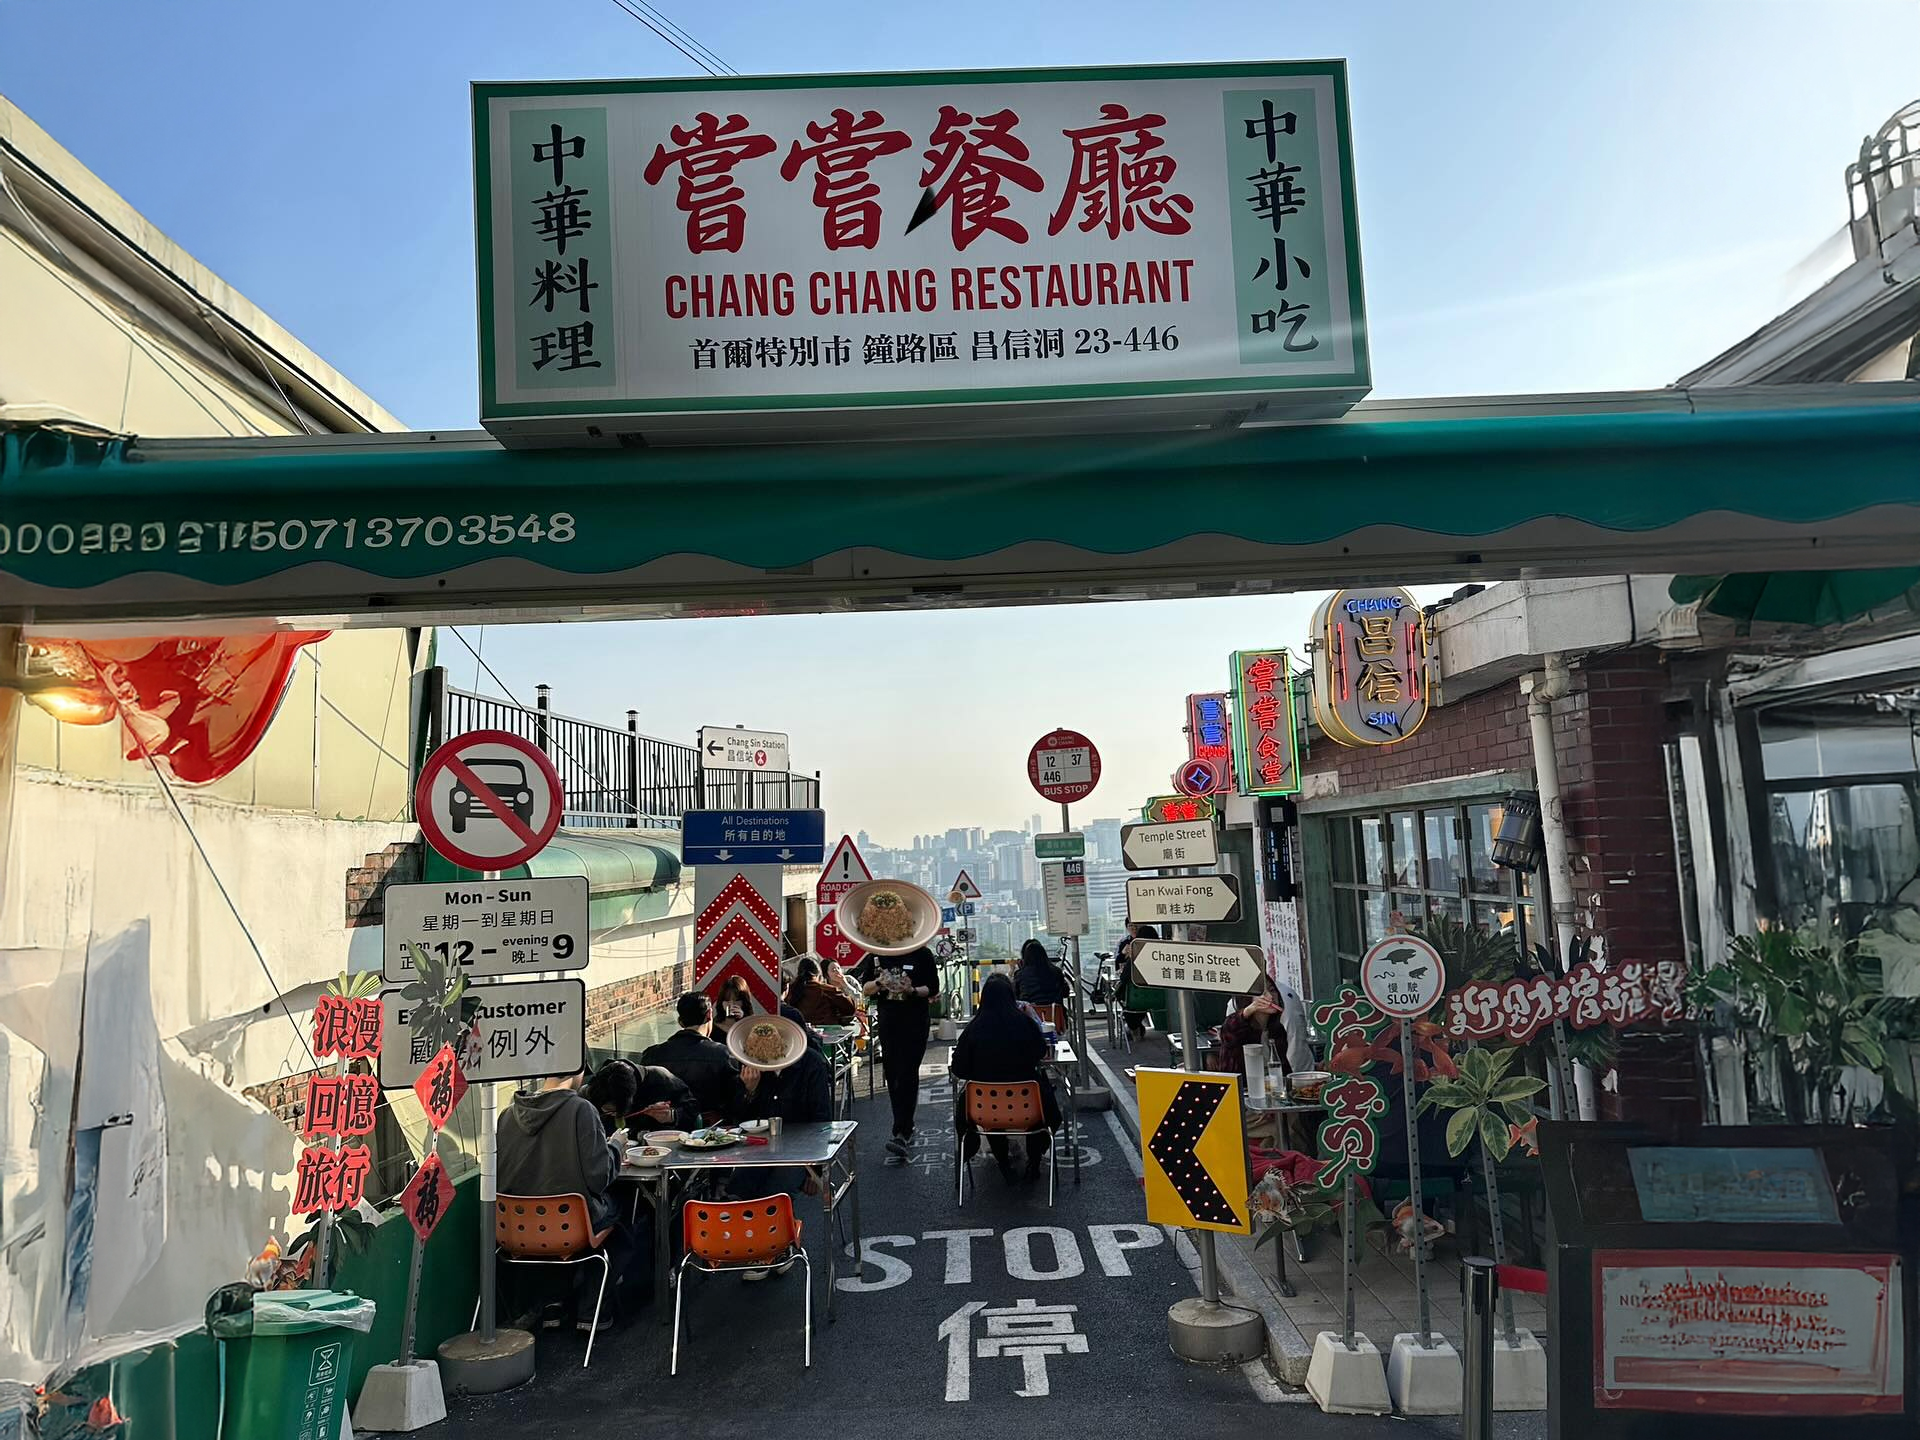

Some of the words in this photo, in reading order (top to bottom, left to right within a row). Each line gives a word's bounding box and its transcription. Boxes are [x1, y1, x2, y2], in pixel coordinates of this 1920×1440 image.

[642, 102, 1195, 255] 嘗嘗餐廳
[1244, 99, 1319, 355] 中華小吃
[530, 123, 601, 373] 中華料理
[665, 272, 796, 320] CHANG
[809, 267, 938, 315] CHANG
[951, 258, 1195, 311] RESTAURANT
[689, 335, 853, 370] 首爾特別市
[862, 331, 960, 366] 鐘路區
[970, 328, 1066, 361] 昌信洞
[1074, 325, 1180, 355] 23-446
[1346, 596, 1403, 614] CHANG
[1357, 615, 1403, 703] 昌信
[1367, 711, 1397, 726] SIN
[727, 736, 749, 749] Chang
[750, 738, 761, 748] Sin
[762, 739, 786, 750] Station
[1046, 755, 1057, 768] 12
[1071, 753, 1082, 766] 37
[1043, 770, 1062, 783] 446
[1044, 786, 1063, 796] BUS
[1064, 784, 1089, 794] STOP
[721, 816, 734, 825] All
[736, 816, 790, 826] Destinations
[1139, 830, 1175, 844] Temple
[1176, 828, 1207, 840] Street
[1065, 863, 1081, 874] 446
[820, 883, 842, 892] ROAD
[1136, 887, 1156, 897] Lan
[1157, 884, 1183, 896] Kwai
[1185, 884, 1214, 898] Fong
[422, 909, 555, 932] 星期一到星期日
[502, 934, 549, 947] evening
[551, 933, 575, 959] 9
[834, 940, 852, 959] 停
[511, 949, 540, 964] 晚上
[1151, 949, 1186, 966] Chang
[1187, 951, 1204, 965] Sin
[1206, 954, 1241, 967] Street
[1192, 968, 1232, 984] 昌信路
[1387, 993, 1420, 1005] SLOW
[316, 999, 382, 1053] 浪漫
[307, 1077, 375, 1133] 回憶
[296, 1151, 368, 1209] 旅行
[834, 1223, 1164, 1293] STOP
[937, 1298, 1090, 1402] 停
